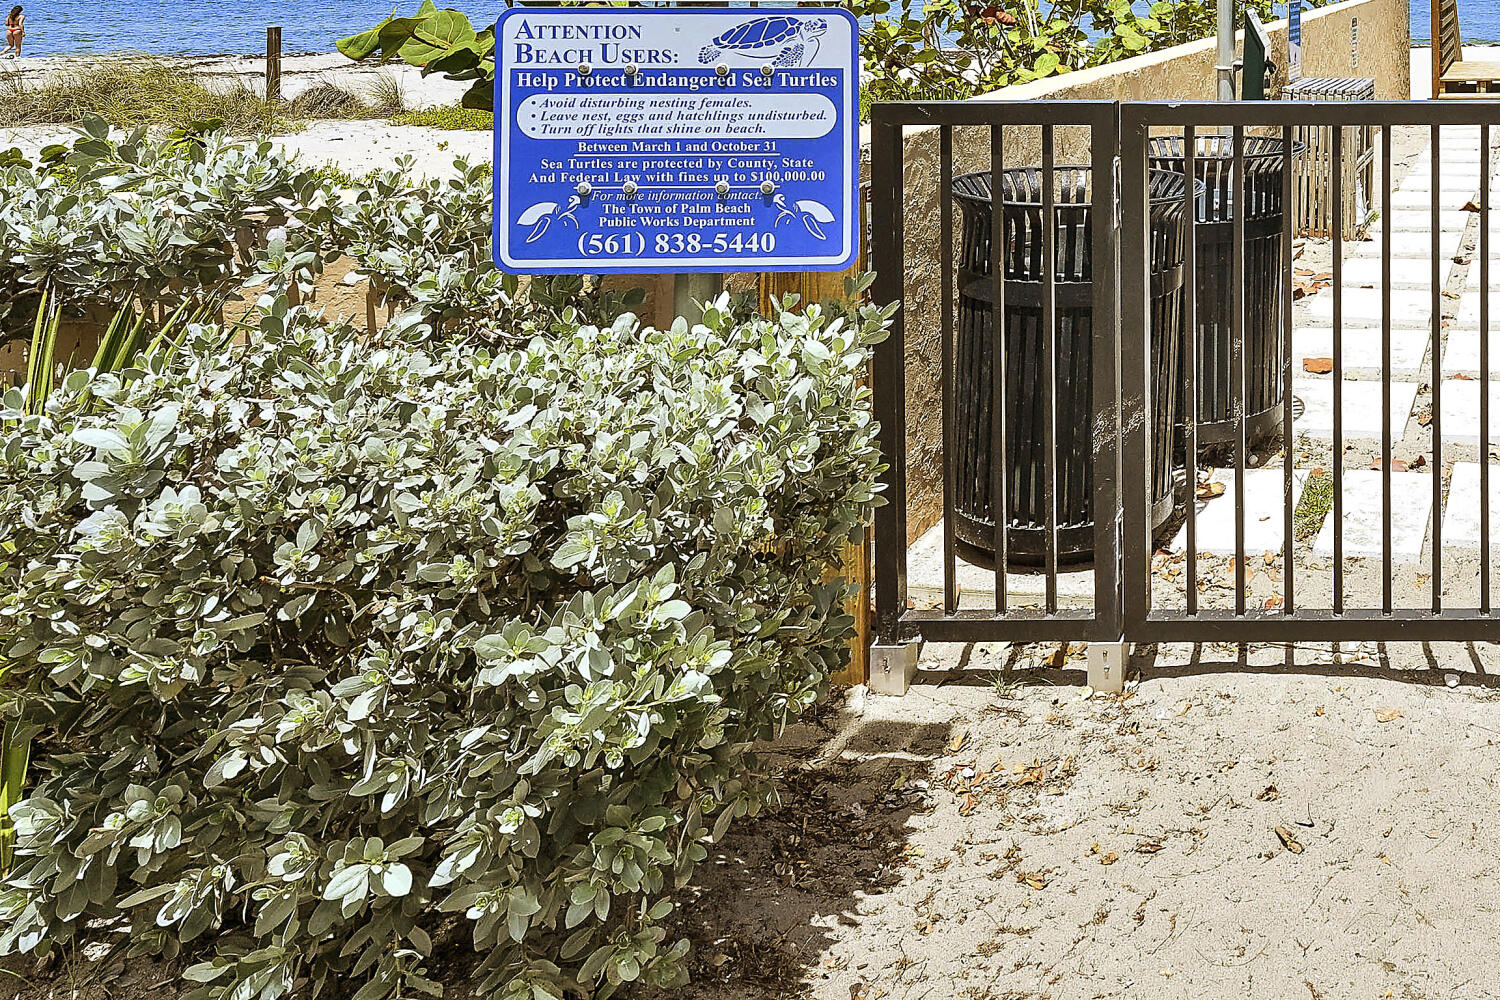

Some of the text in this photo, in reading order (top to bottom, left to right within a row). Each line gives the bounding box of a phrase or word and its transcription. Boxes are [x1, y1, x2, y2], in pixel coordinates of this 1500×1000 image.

[514, 19, 642, 40] ATTENTION
[514, 43, 678, 64] BEACH USERS:
[516, 72, 838, 91] Help Protect Endangered Sea Turtles
[539, 97, 753, 110] Avoid disturbing nesting females.
[540, 110, 828, 123] Leave nest, eggs and hatchlings undisturbed.
[541, 123, 766, 136] Turn off lights that shine on beach.
[578, 141, 777, 152] Between March 1 and October 31
[540, 157, 814, 171] Sea Turtles are protected by County, State
[528, 172, 555, 183] And
[560, 172, 609, 183] Federal
[614, 172, 641, 183] Law
[645, 172, 674, 182] with
[678, 171, 709, 182] fines
[713, 173, 730, 182] up
[733, 171, 746, 182] to
[591, 191, 614, 201] For
[615, 192, 645, 201] more
[647, 190, 714, 203] information
[602, 203, 751, 214] The Town of Palm Beach
[599, 216, 756, 229] Public Works Department
[577, 231, 776, 256] (561) 838-5440
